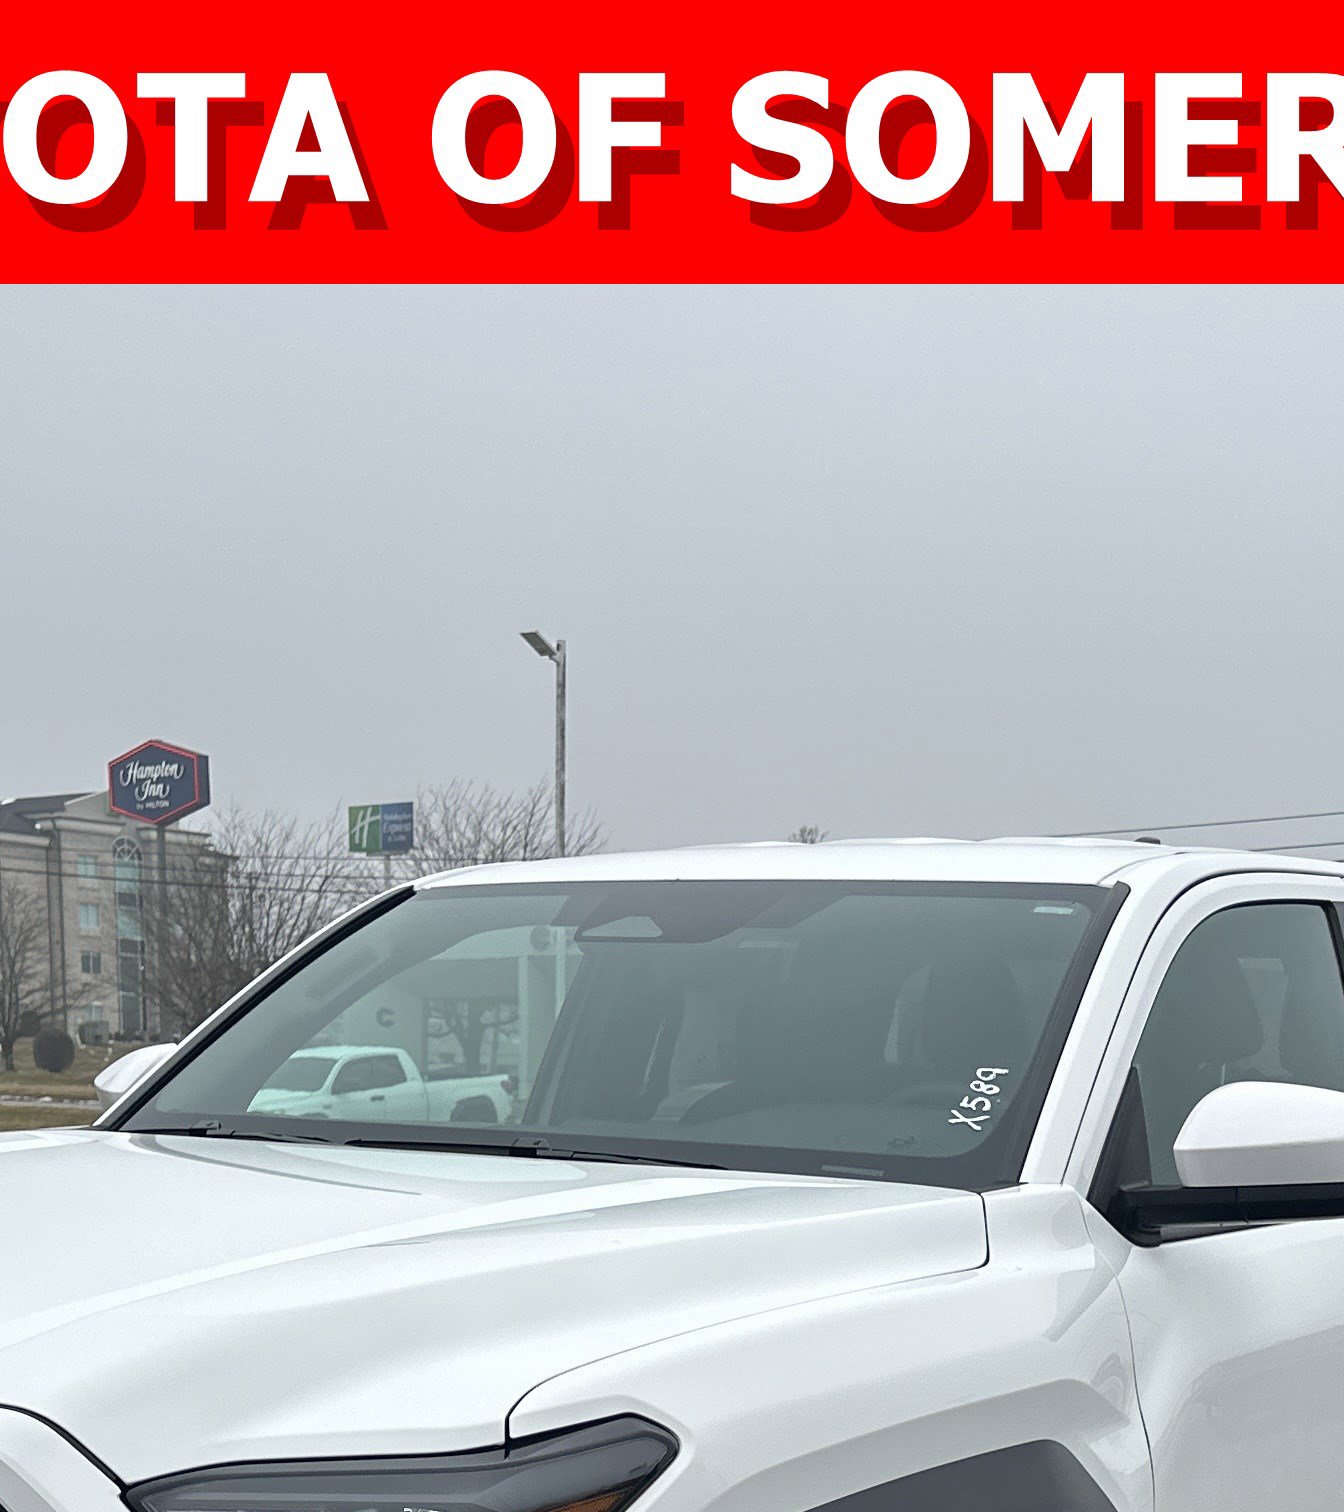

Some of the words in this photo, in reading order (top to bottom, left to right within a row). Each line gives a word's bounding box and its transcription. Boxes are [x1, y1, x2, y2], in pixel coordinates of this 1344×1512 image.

[119, 760, 184, 787] Hampton
[135, 779, 170, 802] Inn
[948, 1067, 1009, 1131] X589
